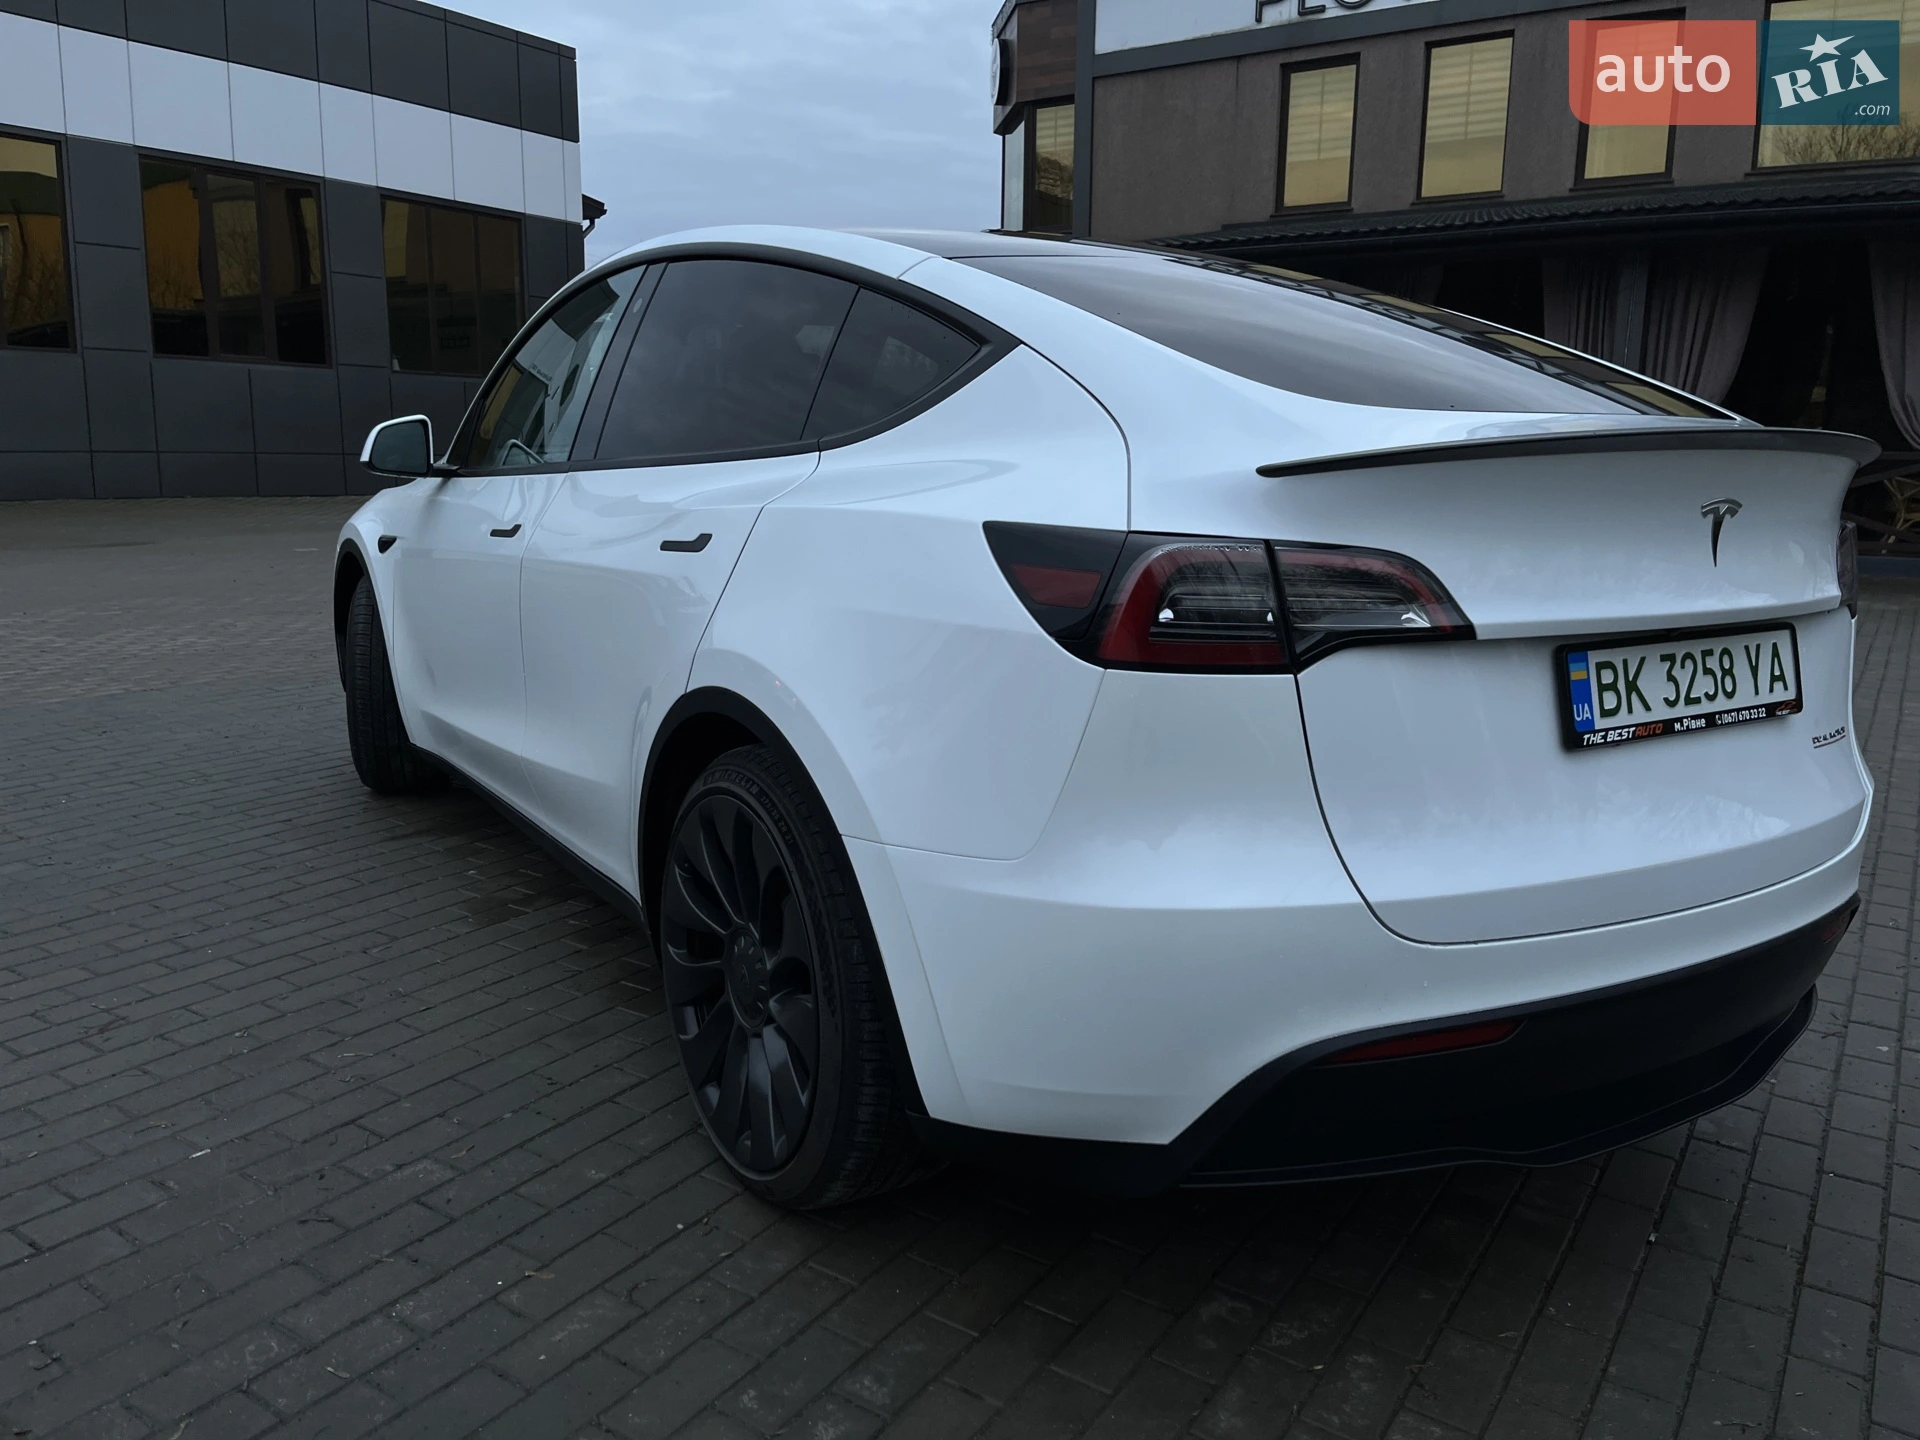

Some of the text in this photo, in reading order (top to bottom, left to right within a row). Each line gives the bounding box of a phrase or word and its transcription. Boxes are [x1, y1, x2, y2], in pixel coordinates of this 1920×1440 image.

[1595, 641, 1789, 718] BK 3258 YA
[1573, 702, 1592, 721] UA
[1721, 711, 1738, 724] (067)
[1738, 711, 1750, 721] 670
[1750, 708, 1758, 719] 33
[1758, 707, 1767, 718] 22
[1582, 731, 1606, 746] THE
